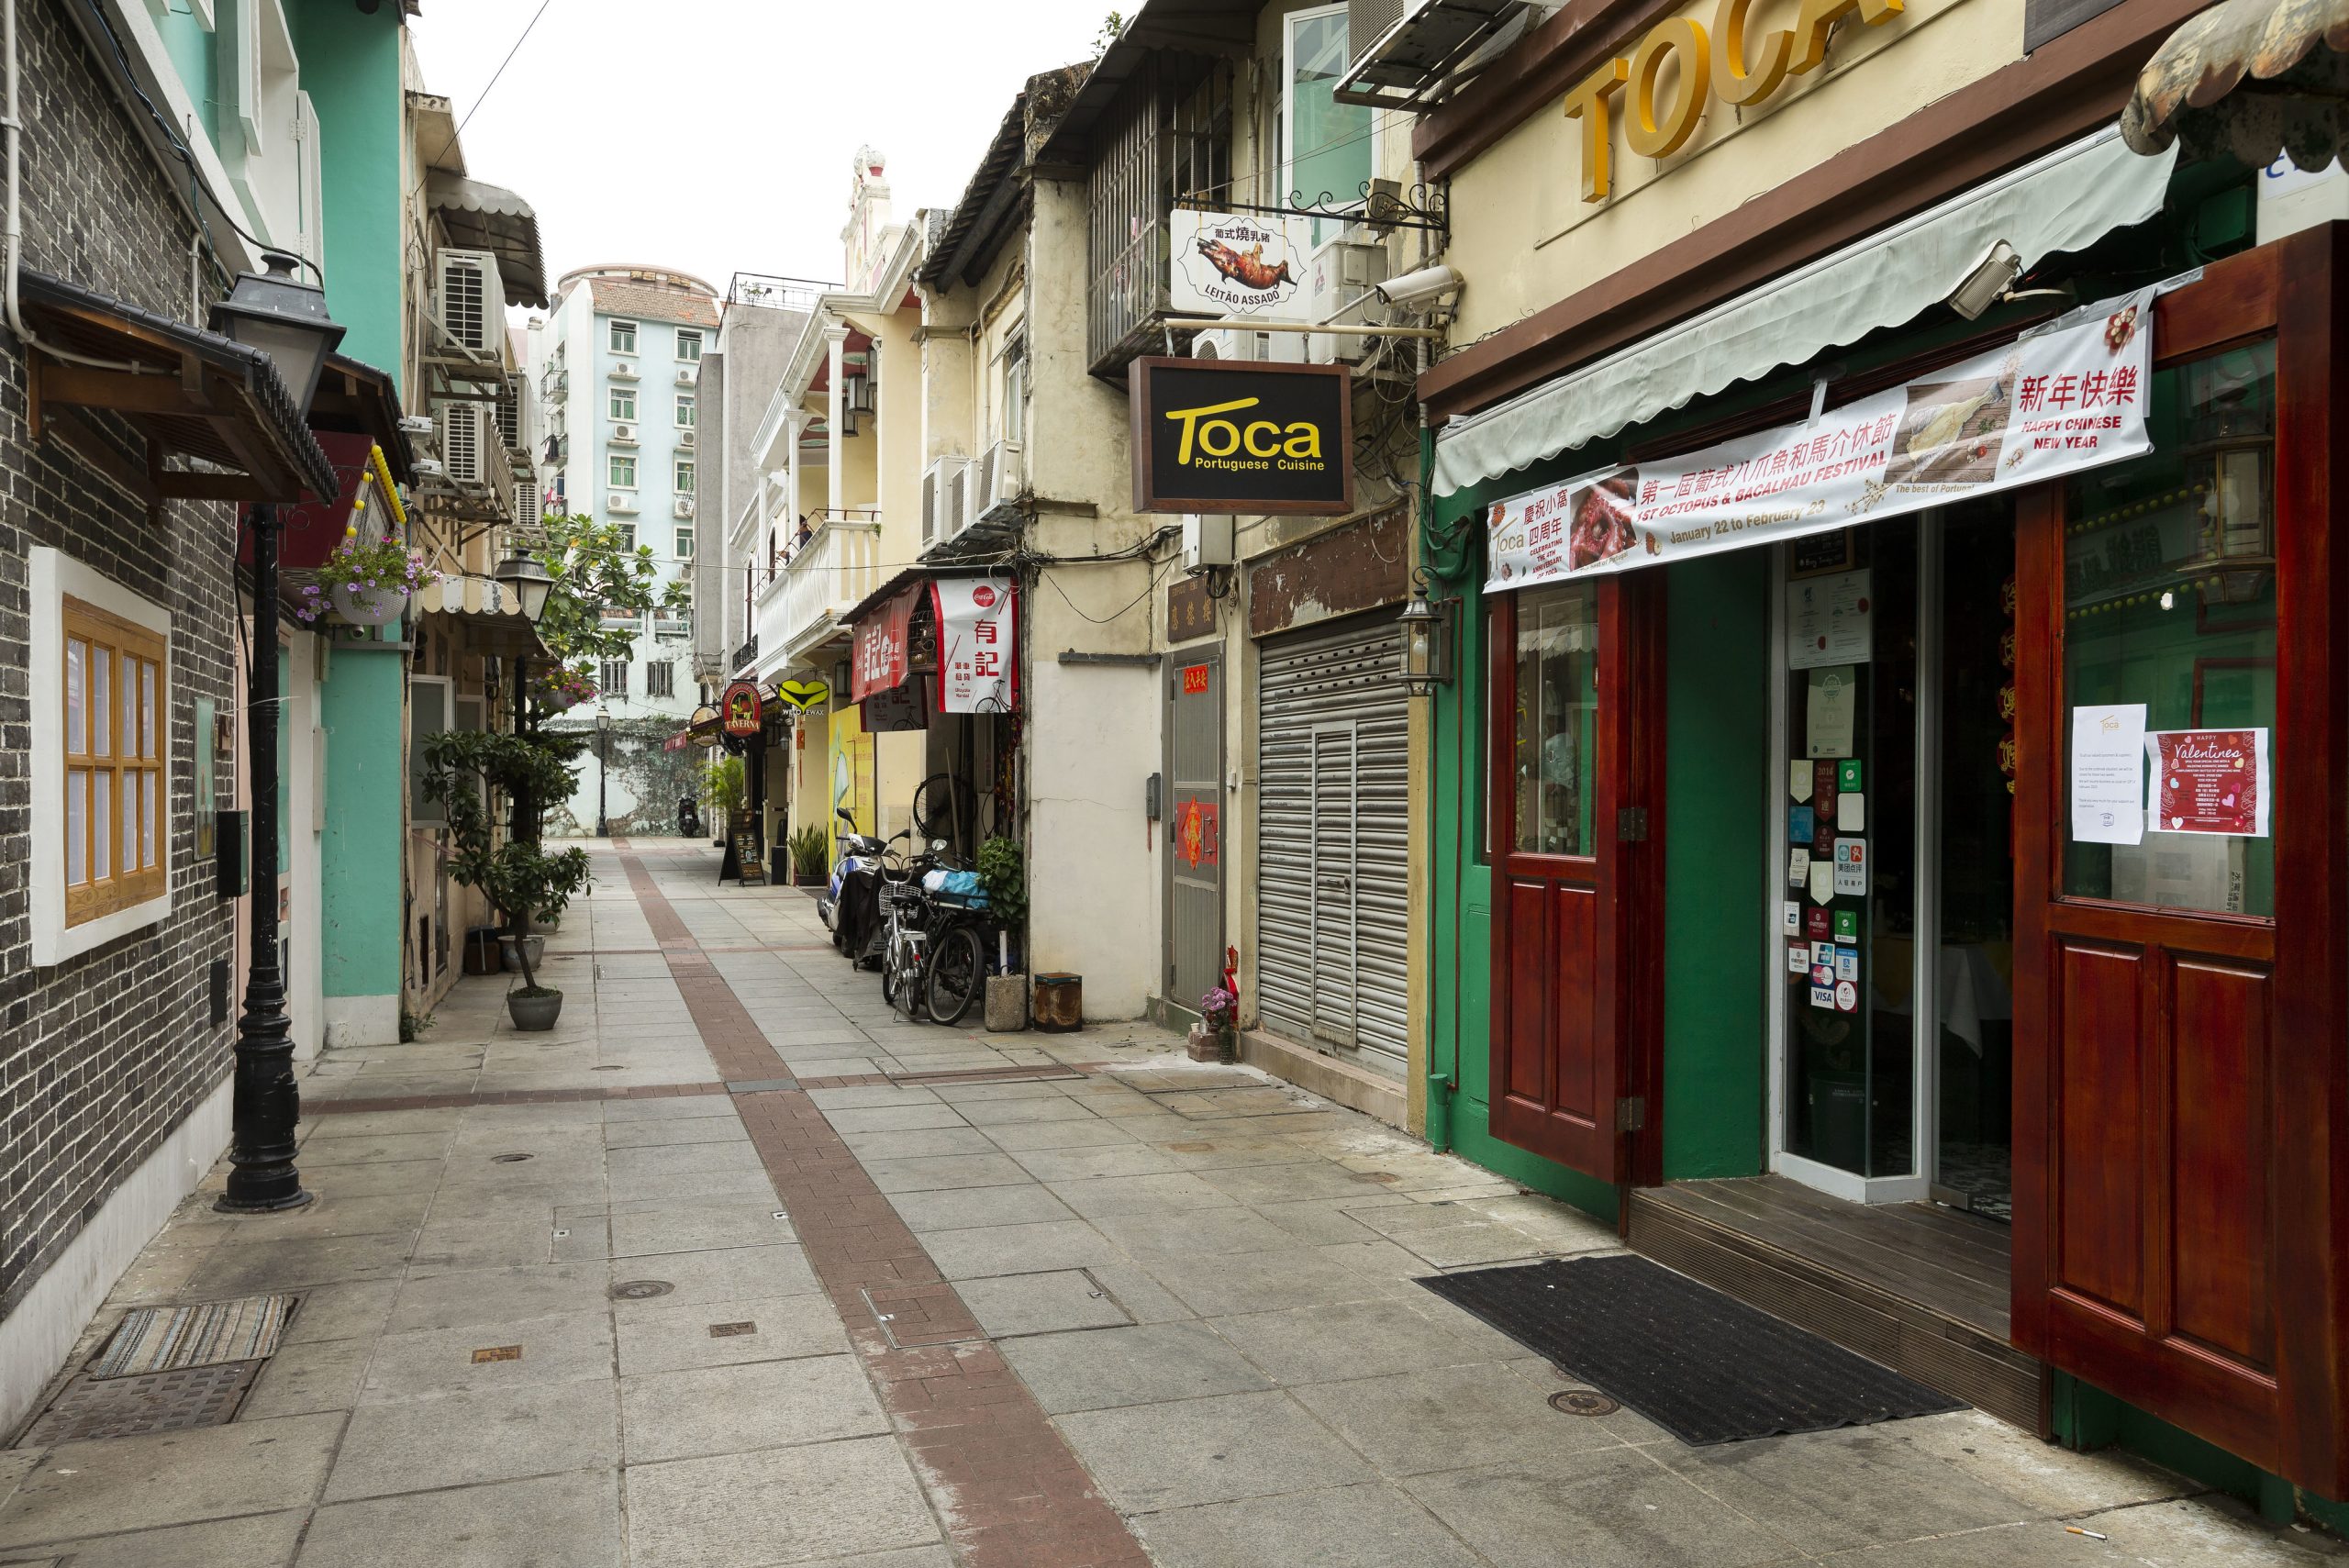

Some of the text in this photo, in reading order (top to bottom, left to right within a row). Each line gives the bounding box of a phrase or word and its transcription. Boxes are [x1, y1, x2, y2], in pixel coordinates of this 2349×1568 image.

[1215, 226, 1271, 243] 葡式燒乳豬
[1205, 284, 1280, 306] LEITÃO ASSADO
[2019, 365, 2138, 413] 新年快樂
[1166, 396, 1322, 465] Toca
[2021, 415, 2121, 434] HAPPY CHINESE
[2033, 435, 2098, 450] NEW YEAR
[1196, 458, 1324, 472] Portuguese Cuisine
[1641, 413, 1897, 506] 第一屆葡式八爪魚和馬介休節
[1637, 450, 1887, 523] 1ST OCTOPUS & BACALHAU FESTIVAL
[1896, 484, 1910, 494] The
[1911, 484, 1929, 494] best
[1931, 484, 1940, 494] of
[1523, 488, 1568, 526] 慶祝小窩
[1670, 499, 1826, 545] January 22 to February 23
[1528, 517, 1563, 548] 四周年
[1492, 517, 1524, 570] Toca
[1530, 537, 1563, 557] CELEBRATING
[1532, 556, 1563, 574] ANNIVERSARY
[1537, 549, 1556, 562] THE 4TH
[974, 618, 999, 677] 有記
[724, 719, 760, 729] TAVERNA
[2175, 741, 2243, 758] Valentines
[1838, 863, 1862, 873] 美团点评
[1814, 991, 1831, 1003] VISA
